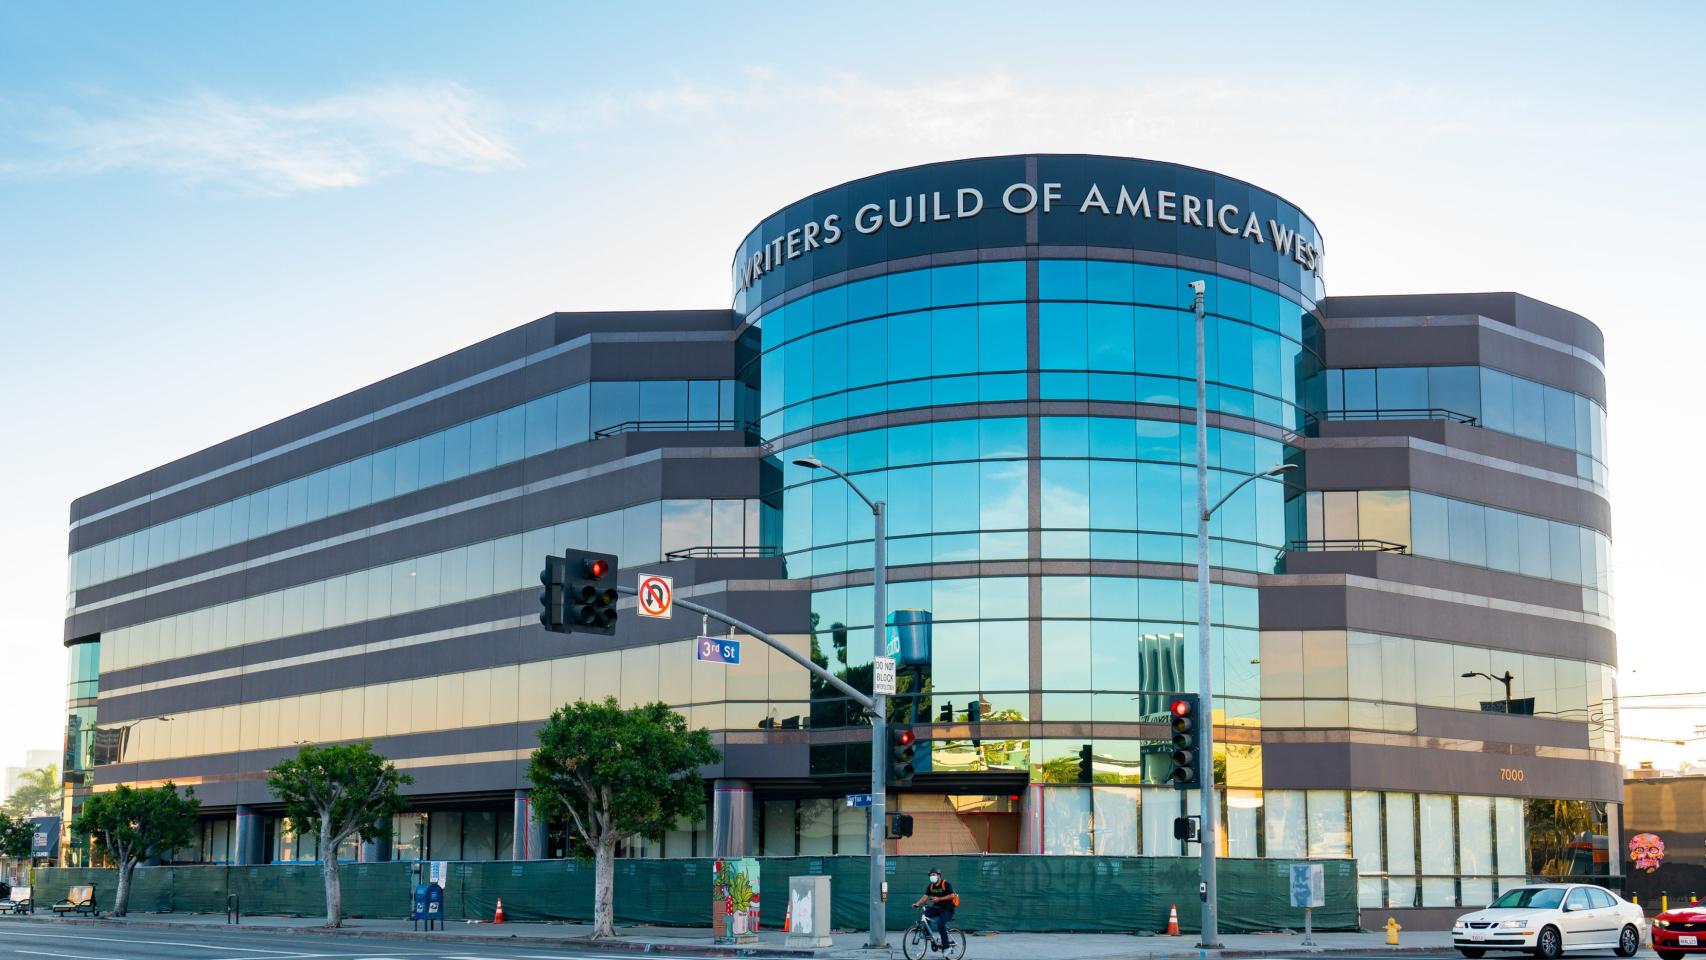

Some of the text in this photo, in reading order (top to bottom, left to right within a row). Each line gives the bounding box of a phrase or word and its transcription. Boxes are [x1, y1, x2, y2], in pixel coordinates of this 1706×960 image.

[740, 182, 1320, 292] WRITERS GUILD OF AMERICA WEST
[702, 641, 736, 658] 3rd St
[876, 662, 895, 671] DO NOT
[876, 673, 894, 682] BLOCK
[1500, 768, 1524, 781] 7000
